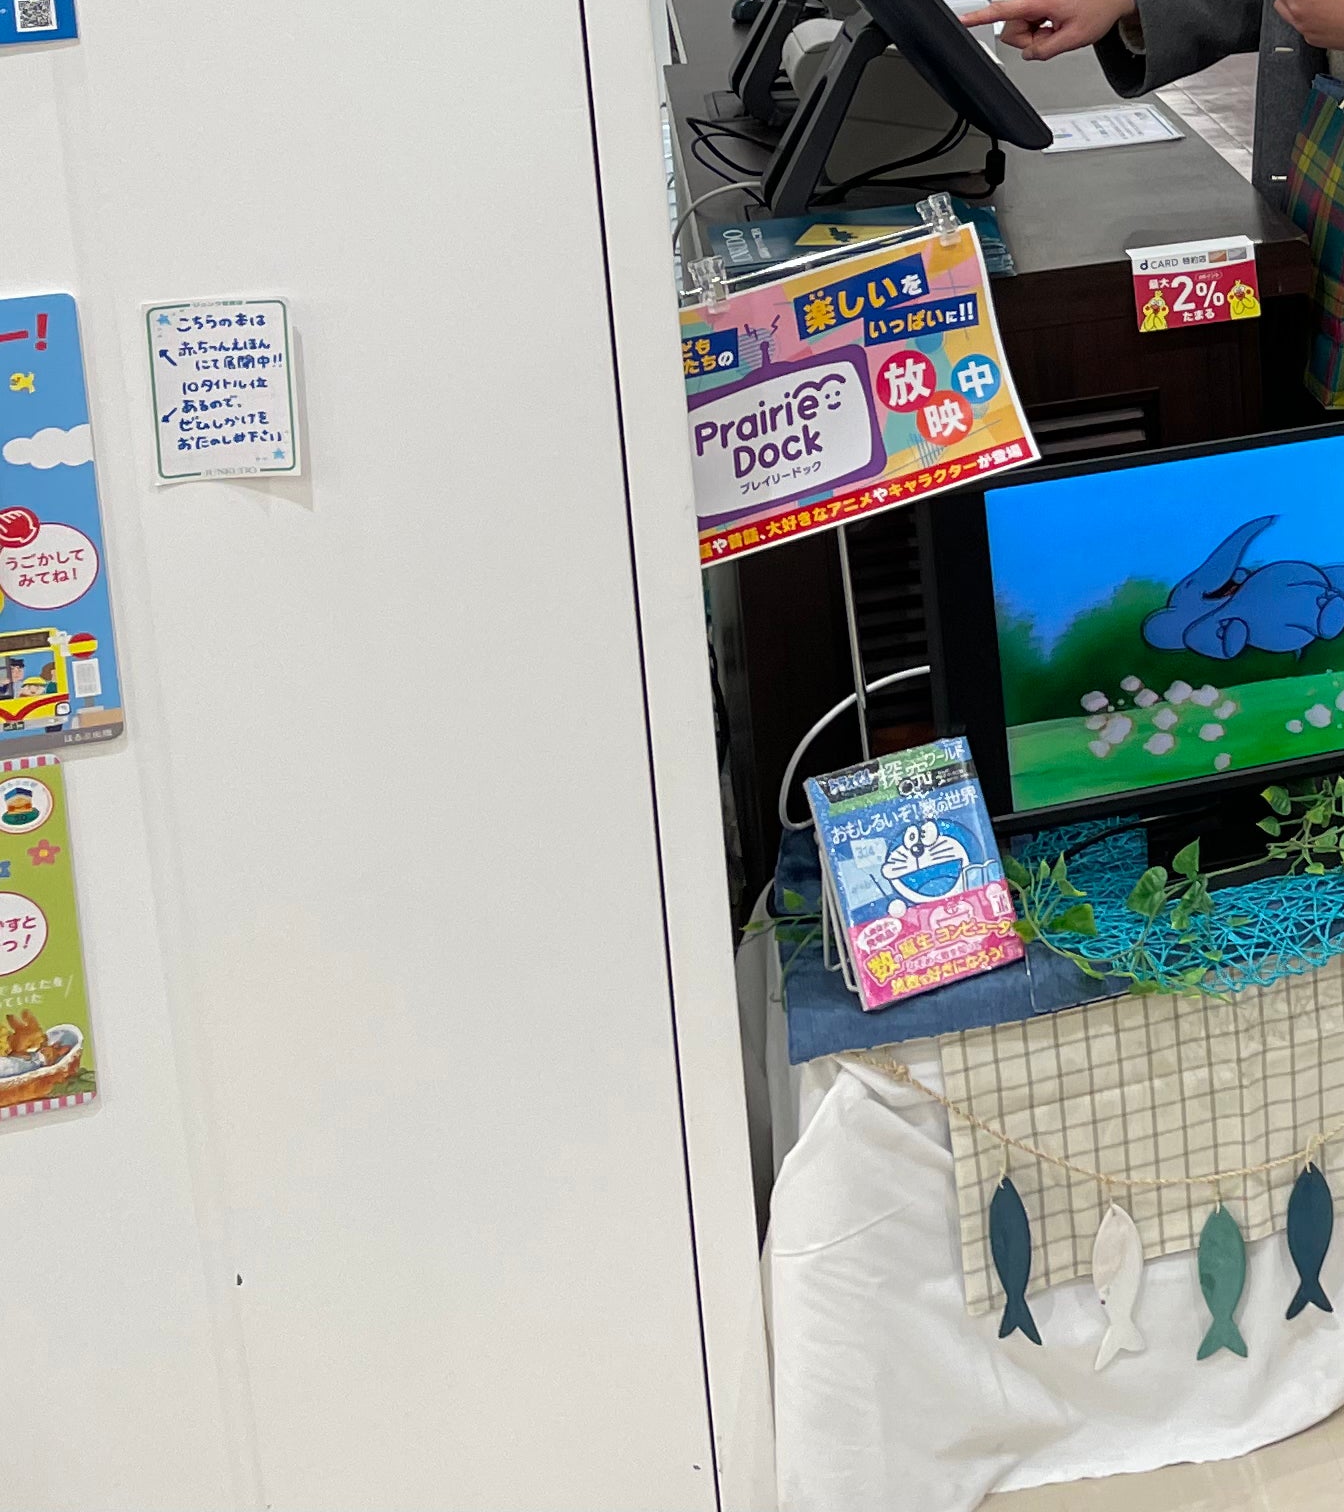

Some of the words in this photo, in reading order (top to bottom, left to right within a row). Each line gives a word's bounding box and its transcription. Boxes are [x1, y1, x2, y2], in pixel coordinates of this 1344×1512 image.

[1151, 259, 1178, 270] CARD
[804, 274, 922, 334] 楽しいを
[1149, 278, 1170, 290] 最大
[1171, 276, 1225, 312] 2%
[177, 312, 266, 332] こちらの本は
[1182, 309, 1216, 322] たまる
[182, 377, 269, 395] 10タイトル位
[178, 411, 270, 431] ぜひしかけを
[694, 391, 819, 457] Prairie
[733, 424, 823, 479] Dock
[4, 547, 85, 573] うごかして
[18, 566, 79, 588] みてね!
